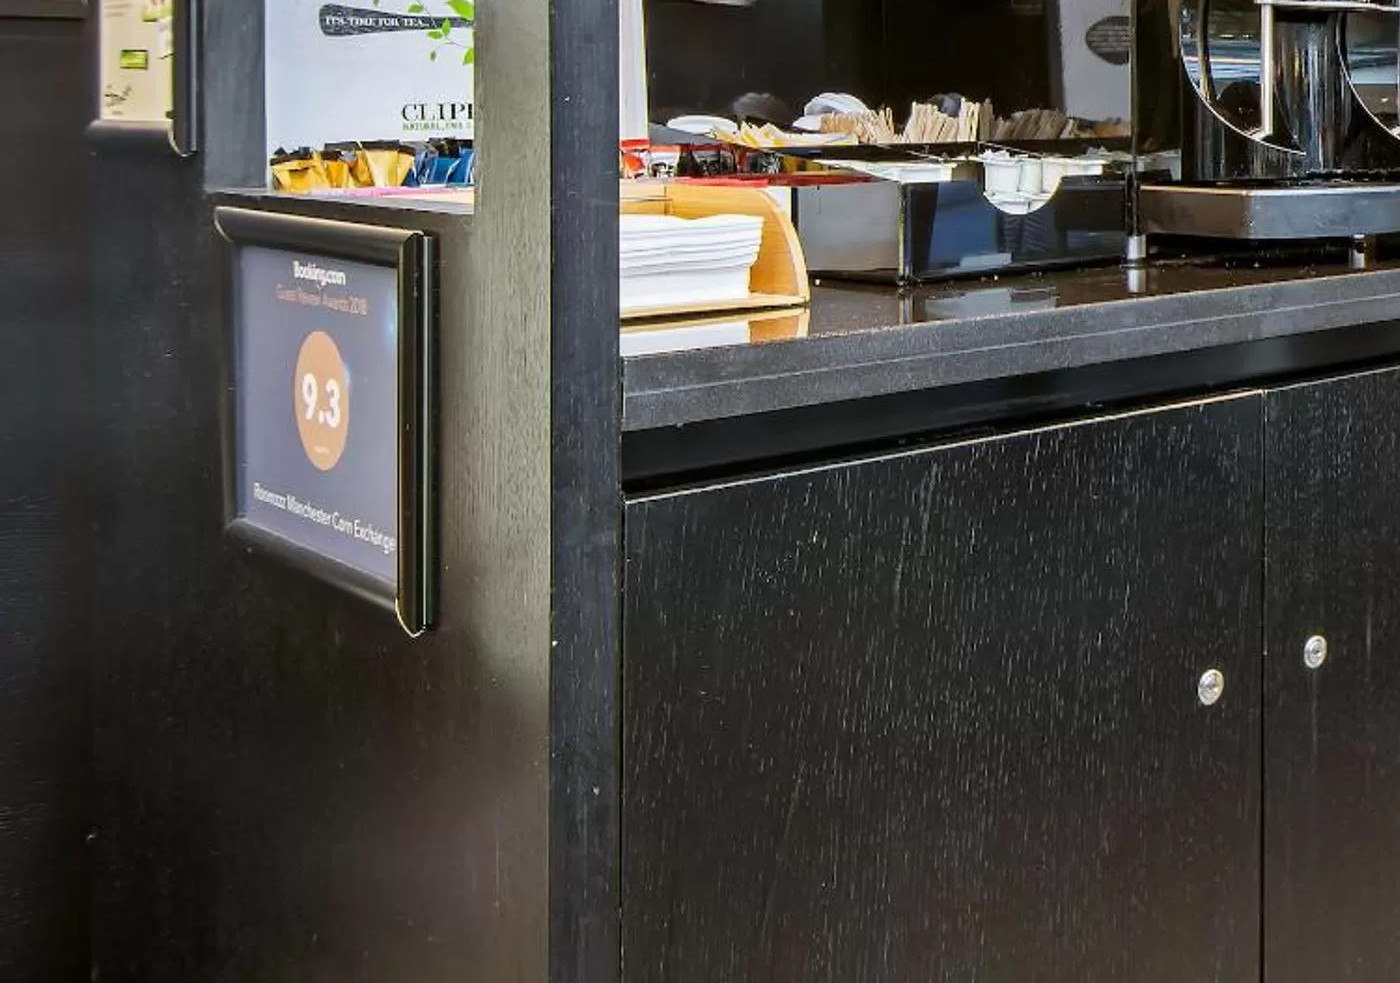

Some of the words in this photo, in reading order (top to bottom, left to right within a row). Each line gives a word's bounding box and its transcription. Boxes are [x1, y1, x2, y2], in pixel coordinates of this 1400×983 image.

[292, 260, 347, 290] Booking.com
[302, 372, 341, 429] 9.3
[286, 494, 331, 526] Manchester
[331, 511, 354, 535] Corn
[353, 519, 397, 555] Exchange
